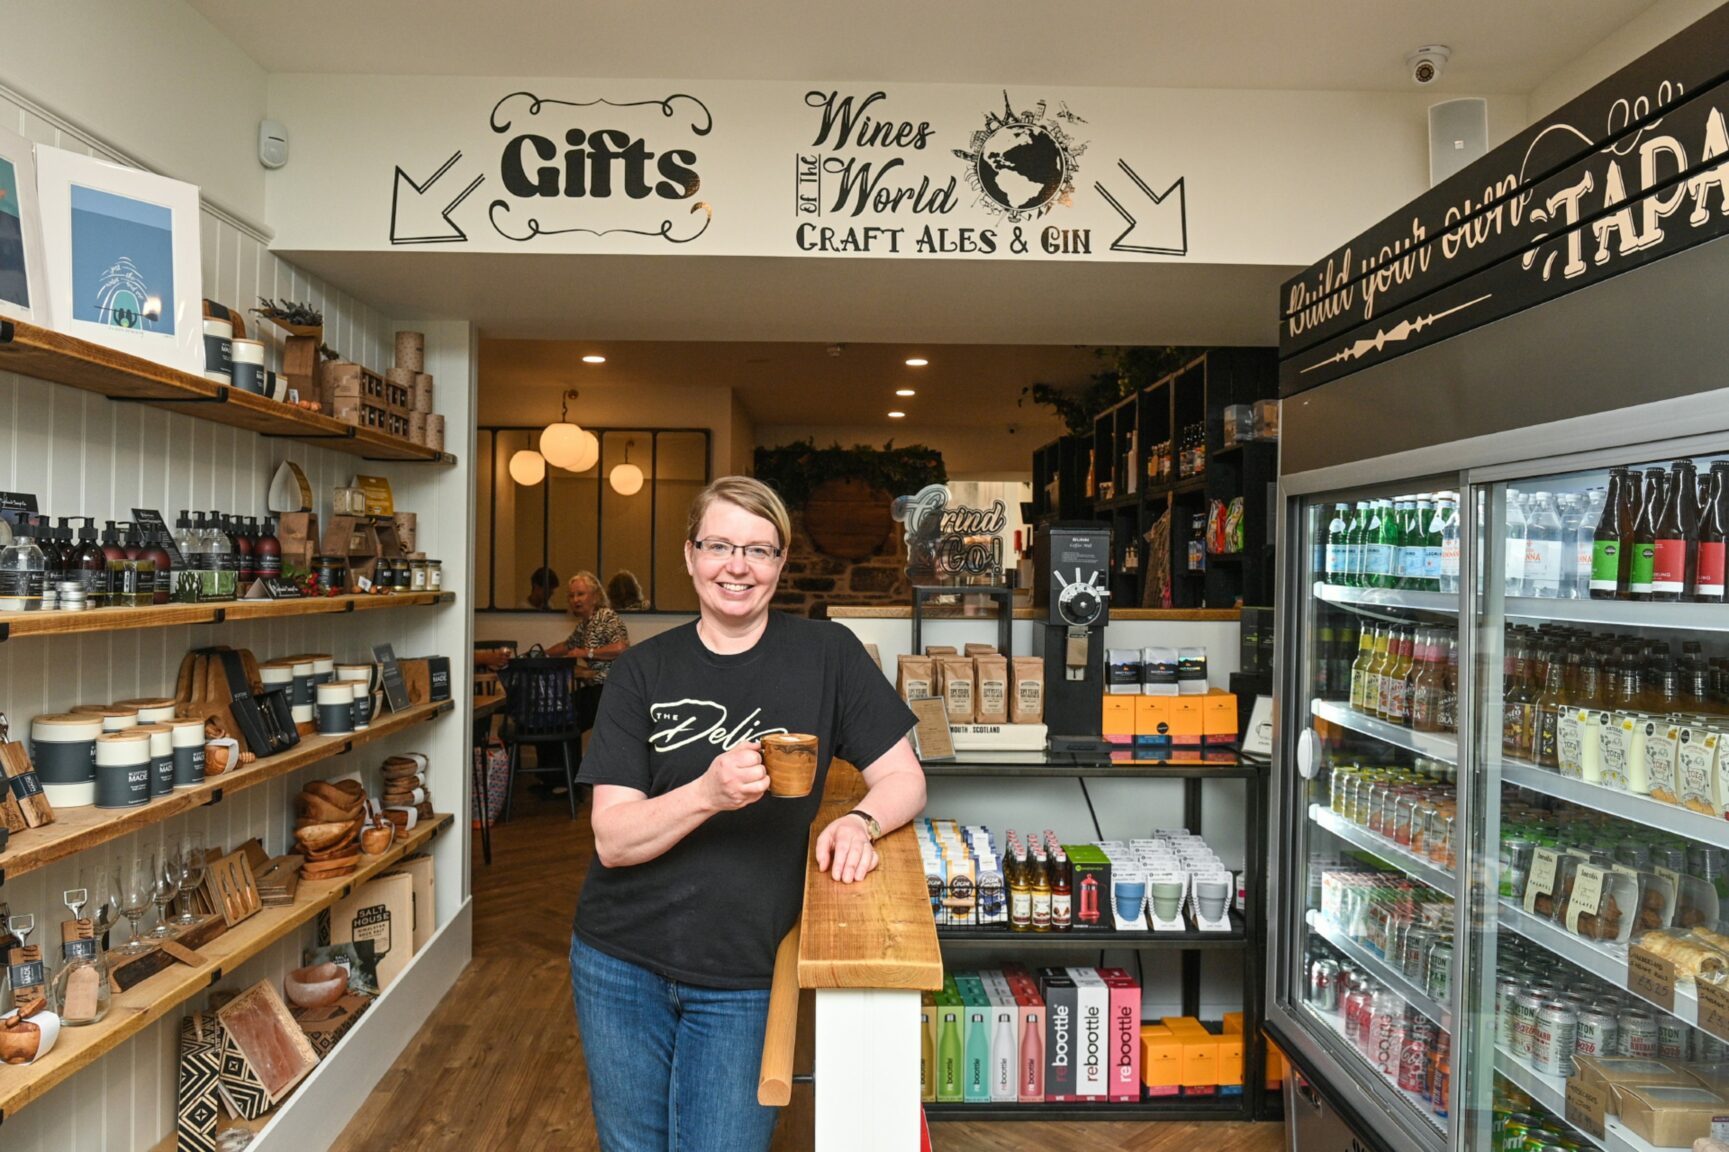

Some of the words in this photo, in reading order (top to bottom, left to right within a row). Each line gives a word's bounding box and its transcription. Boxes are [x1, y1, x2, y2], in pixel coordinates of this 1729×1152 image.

[804, 90, 935, 151] Wines
[500, 128, 701, 200] Gifts
[800, 154, 818, 184] The
[823, 157, 959, 217] World
[796, 222, 905, 253] CRAFT
[916, 225, 998, 254] ALES
[1009, 226, 1029, 254] &
[1041, 225, 1092, 254] GIN
[1286, 247, 1353, 338] Build
[1361, 217, 1432, 320] your
[1441, 173, 1533, 260] own
[904, 488, 1006, 535] Grind
[940, 534, 1003, 574] Go!
[656, 712, 679, 721] THE
[973, 726, 1000, 734] SCOTLAND
[128, 774, 148, 783] MADE
[354, 912, 390, 927] HOUSE
[359, 905, 384, 917] SALT
[1052, 1004, 1069, 1082] reboottle
[1083, 1006, 1099, 1082] reboottle
[1117, 1006, 1132, 1083] reboottle
